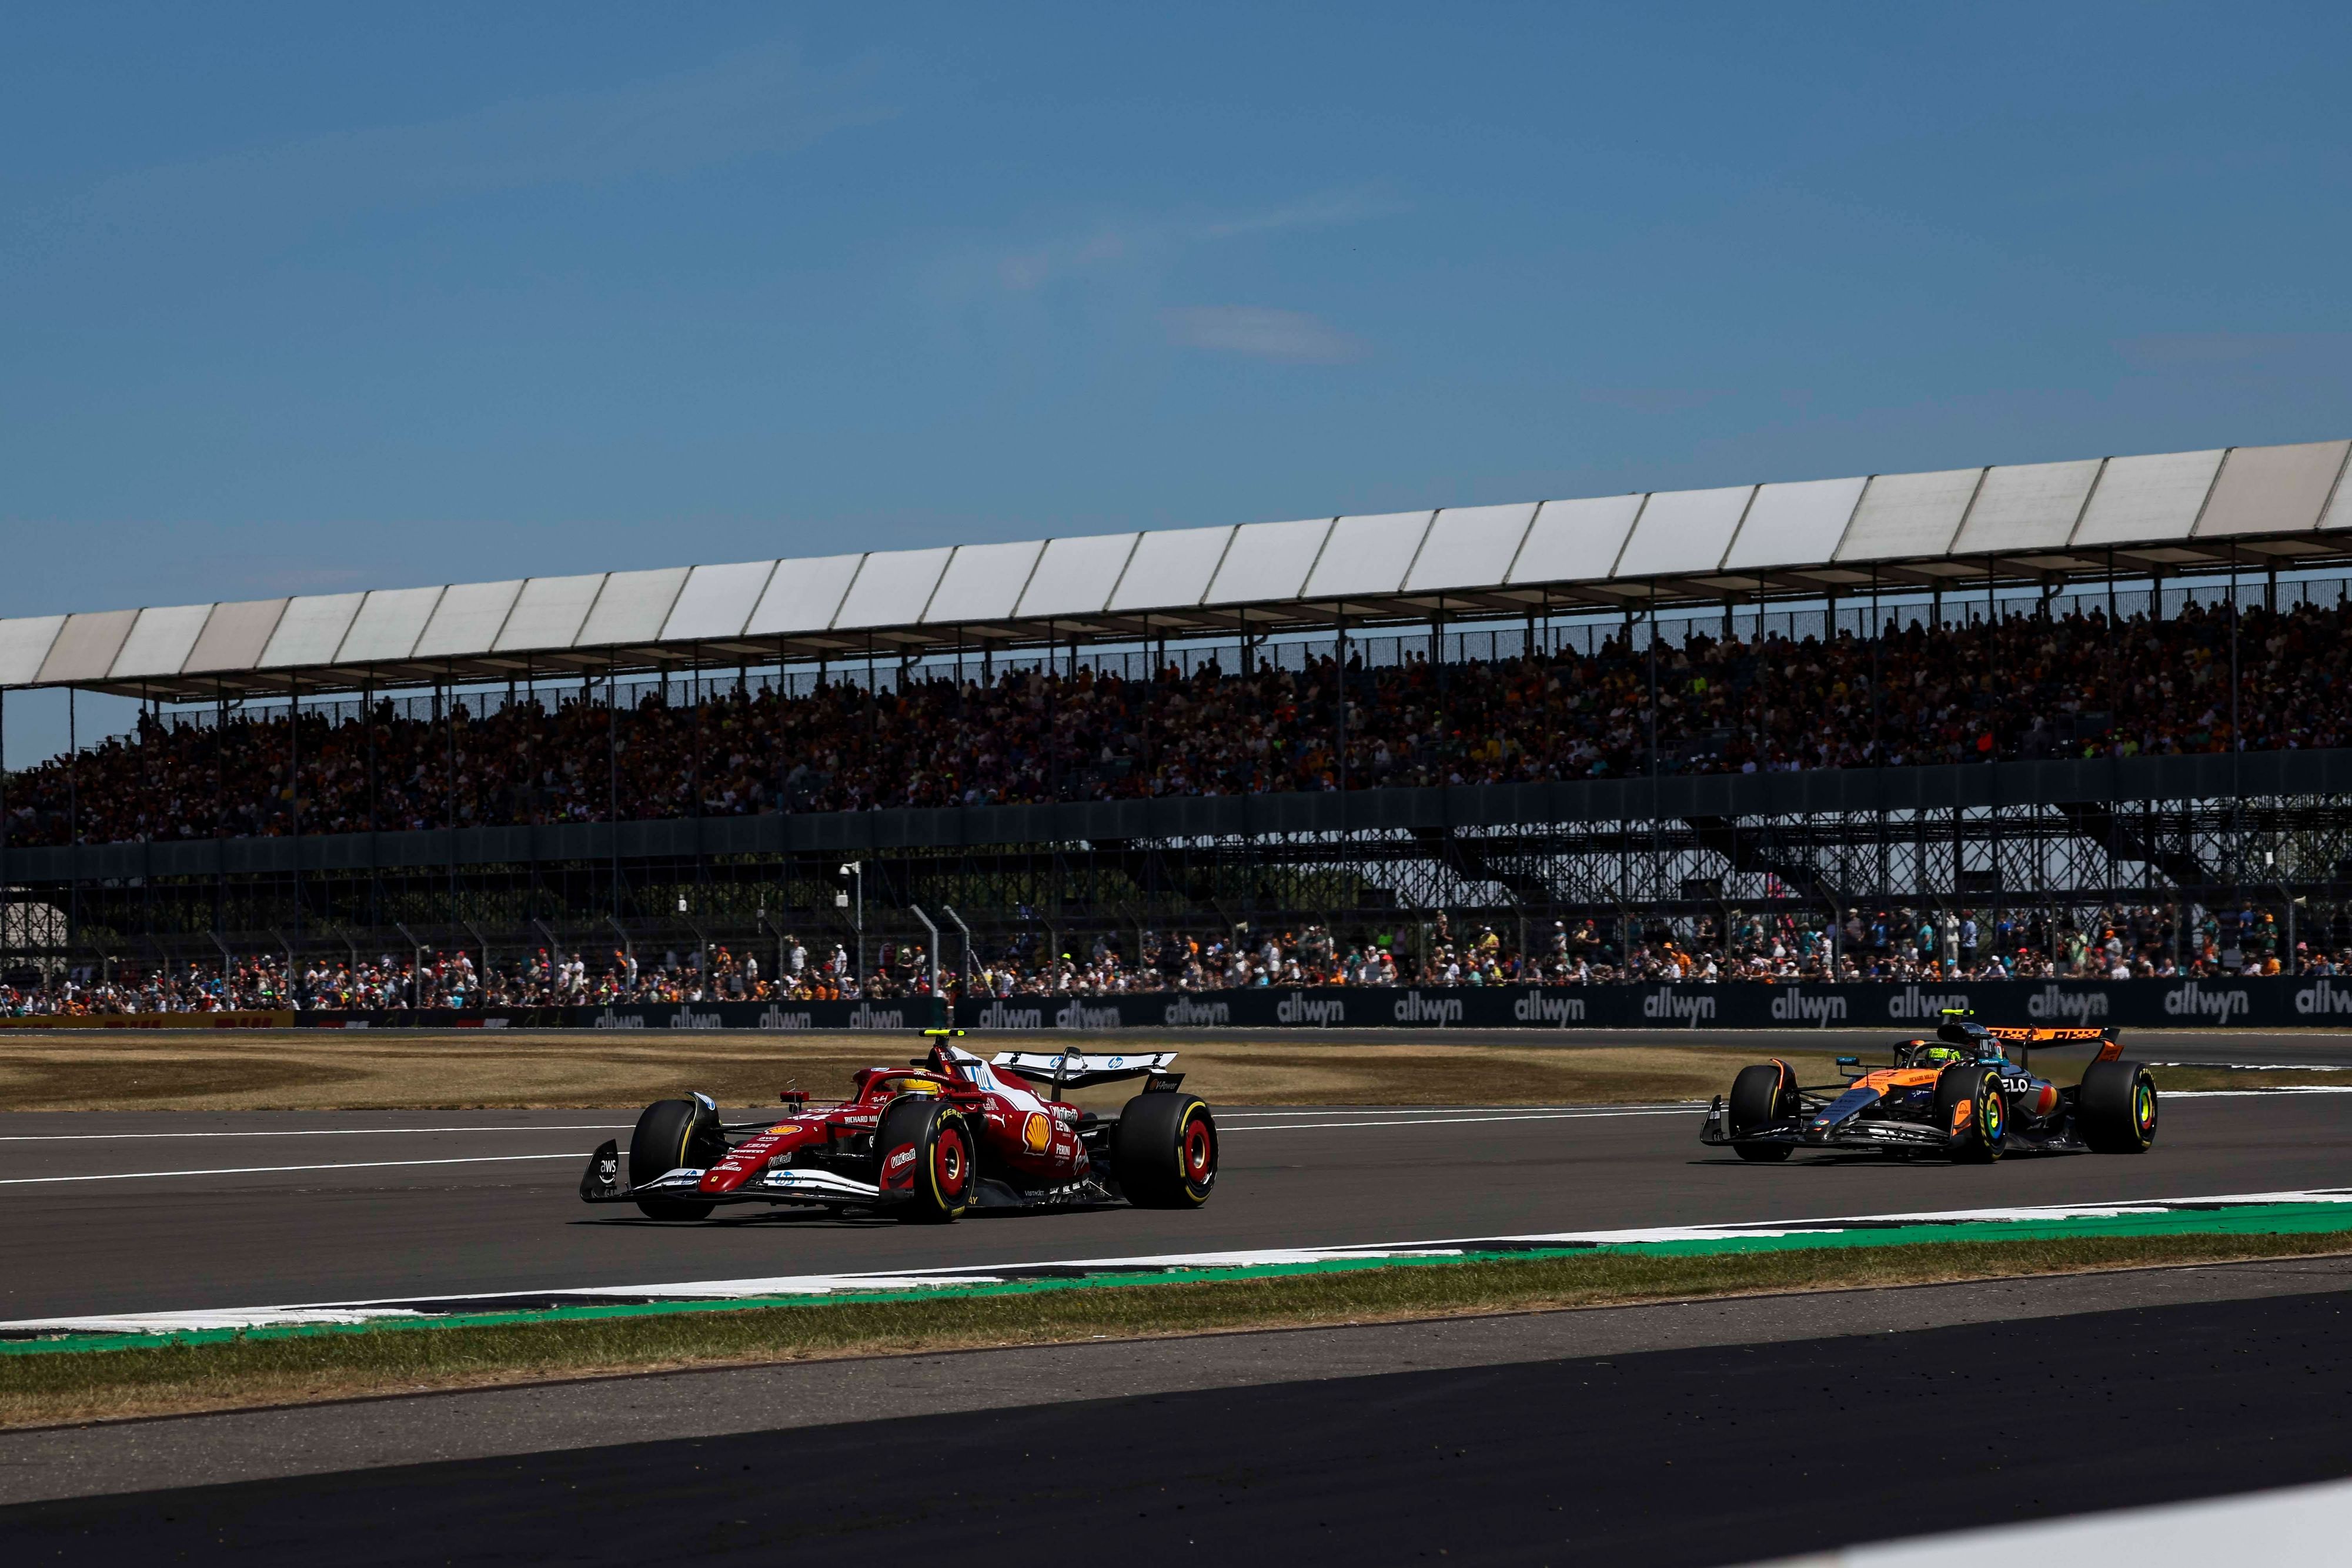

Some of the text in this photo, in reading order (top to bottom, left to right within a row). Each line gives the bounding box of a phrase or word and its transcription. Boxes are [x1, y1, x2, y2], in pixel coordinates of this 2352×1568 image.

[1889, 986, 1969, 1026] allwyn
[2027, 984, 2109, 1027] allwyn
[2164, 981, 2249, 1024] allwyn
[2296, 980, 2352, 1015] allw
[1165, 995, 1230, 1026] allwyn
[1277, 992, 1344, 1028] allwyn
[1394, 991, 1463, 1028] allwyn
[1515, 989, 1585, 1028] allwyn
[1644, 987, 1715, 1028] allwyn
[1771, 988, 1847, 1028] allwyn
[1108, 1057, 1124, 1069] hp
[927, 1072, 950, 1081] TECHNOLOGY
[1156, 1081, 1177, 1090] V-Power
[2001, 1078, 2028, 1093] ELO
[844, 1116, 867, 1124] RICHARD
[941, 1108, 963, 1121] ZERO
[894, 1148, 916, 1167] UniCredit
[1056, 1143, 1070, 1156] PERONI
[600, 1159, 616, 1173] aws
[772, 1152, 792, 1167] UniCredit
[968, 1196, 978, 1205] AY
